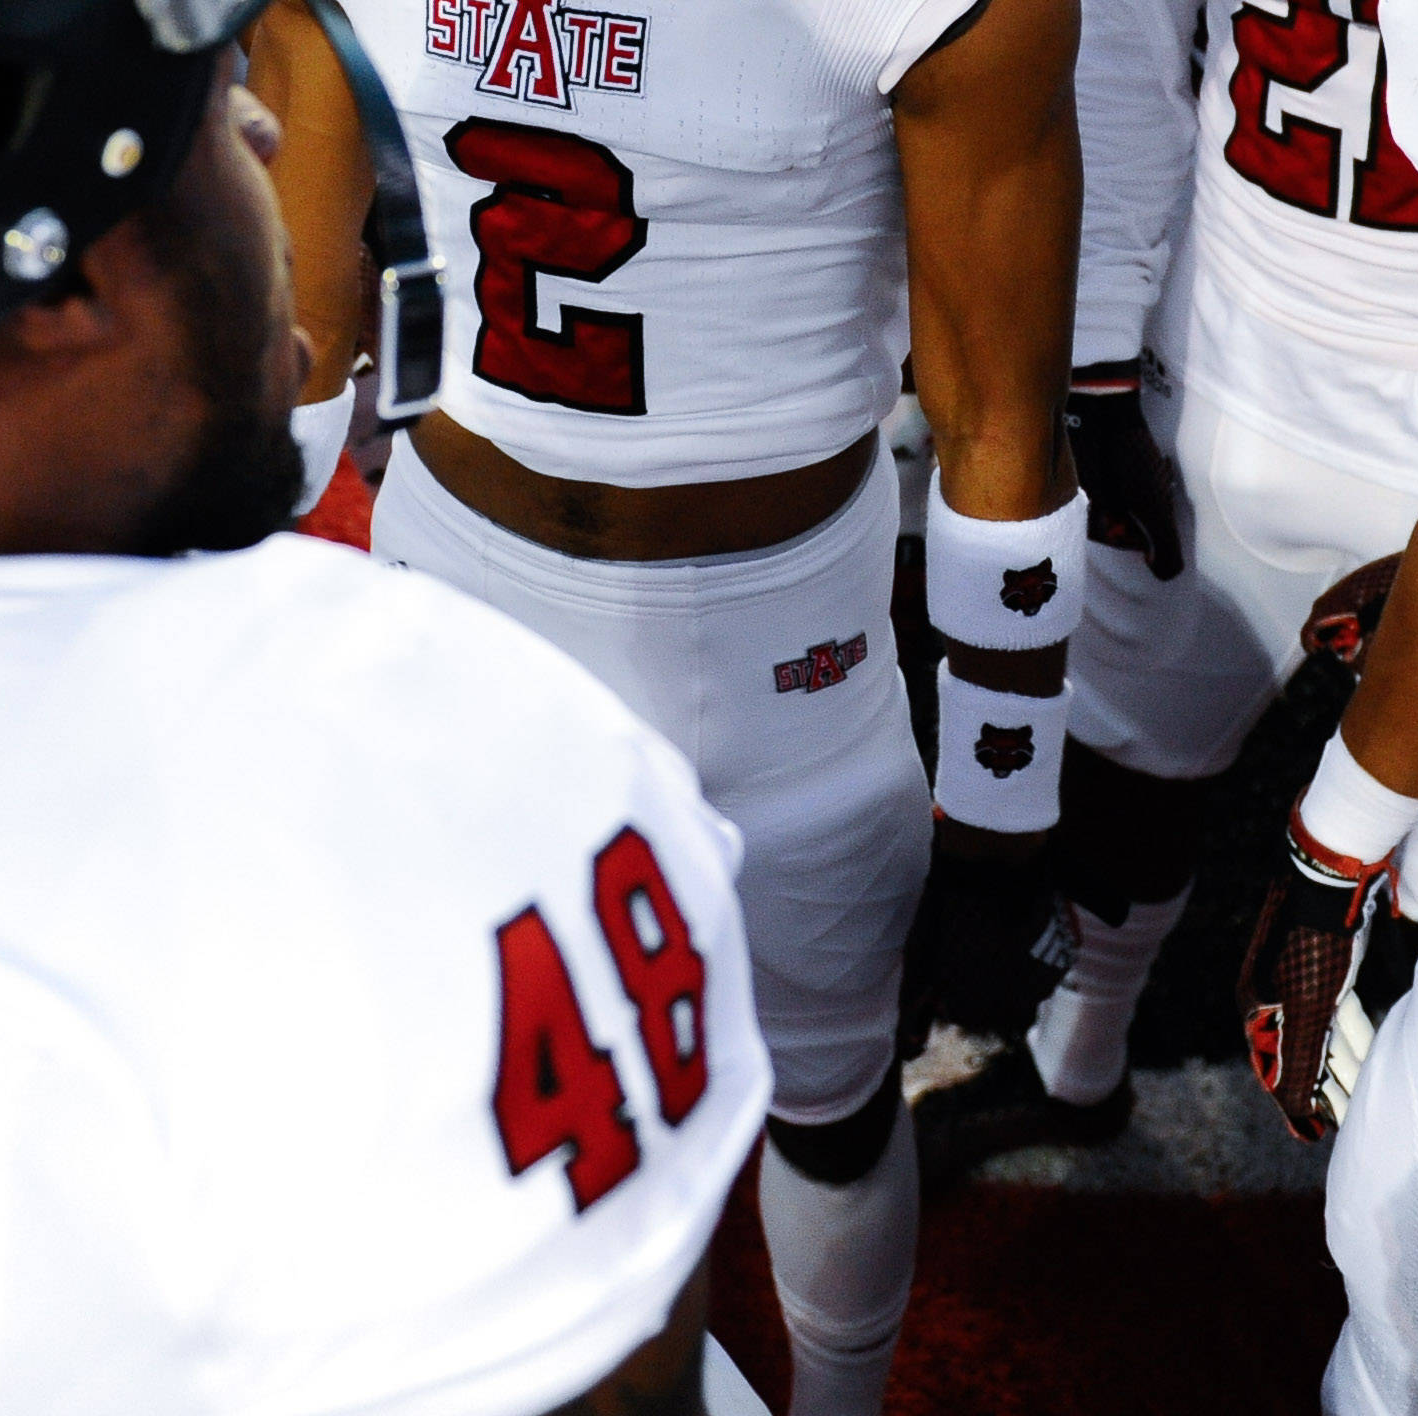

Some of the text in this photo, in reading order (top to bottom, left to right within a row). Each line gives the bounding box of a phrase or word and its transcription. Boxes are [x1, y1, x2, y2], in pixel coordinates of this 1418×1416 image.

[443, 115, 648, 415] 2
[773, 630, 868, 694] STATE
[492, 824, 709, 1215] 48
